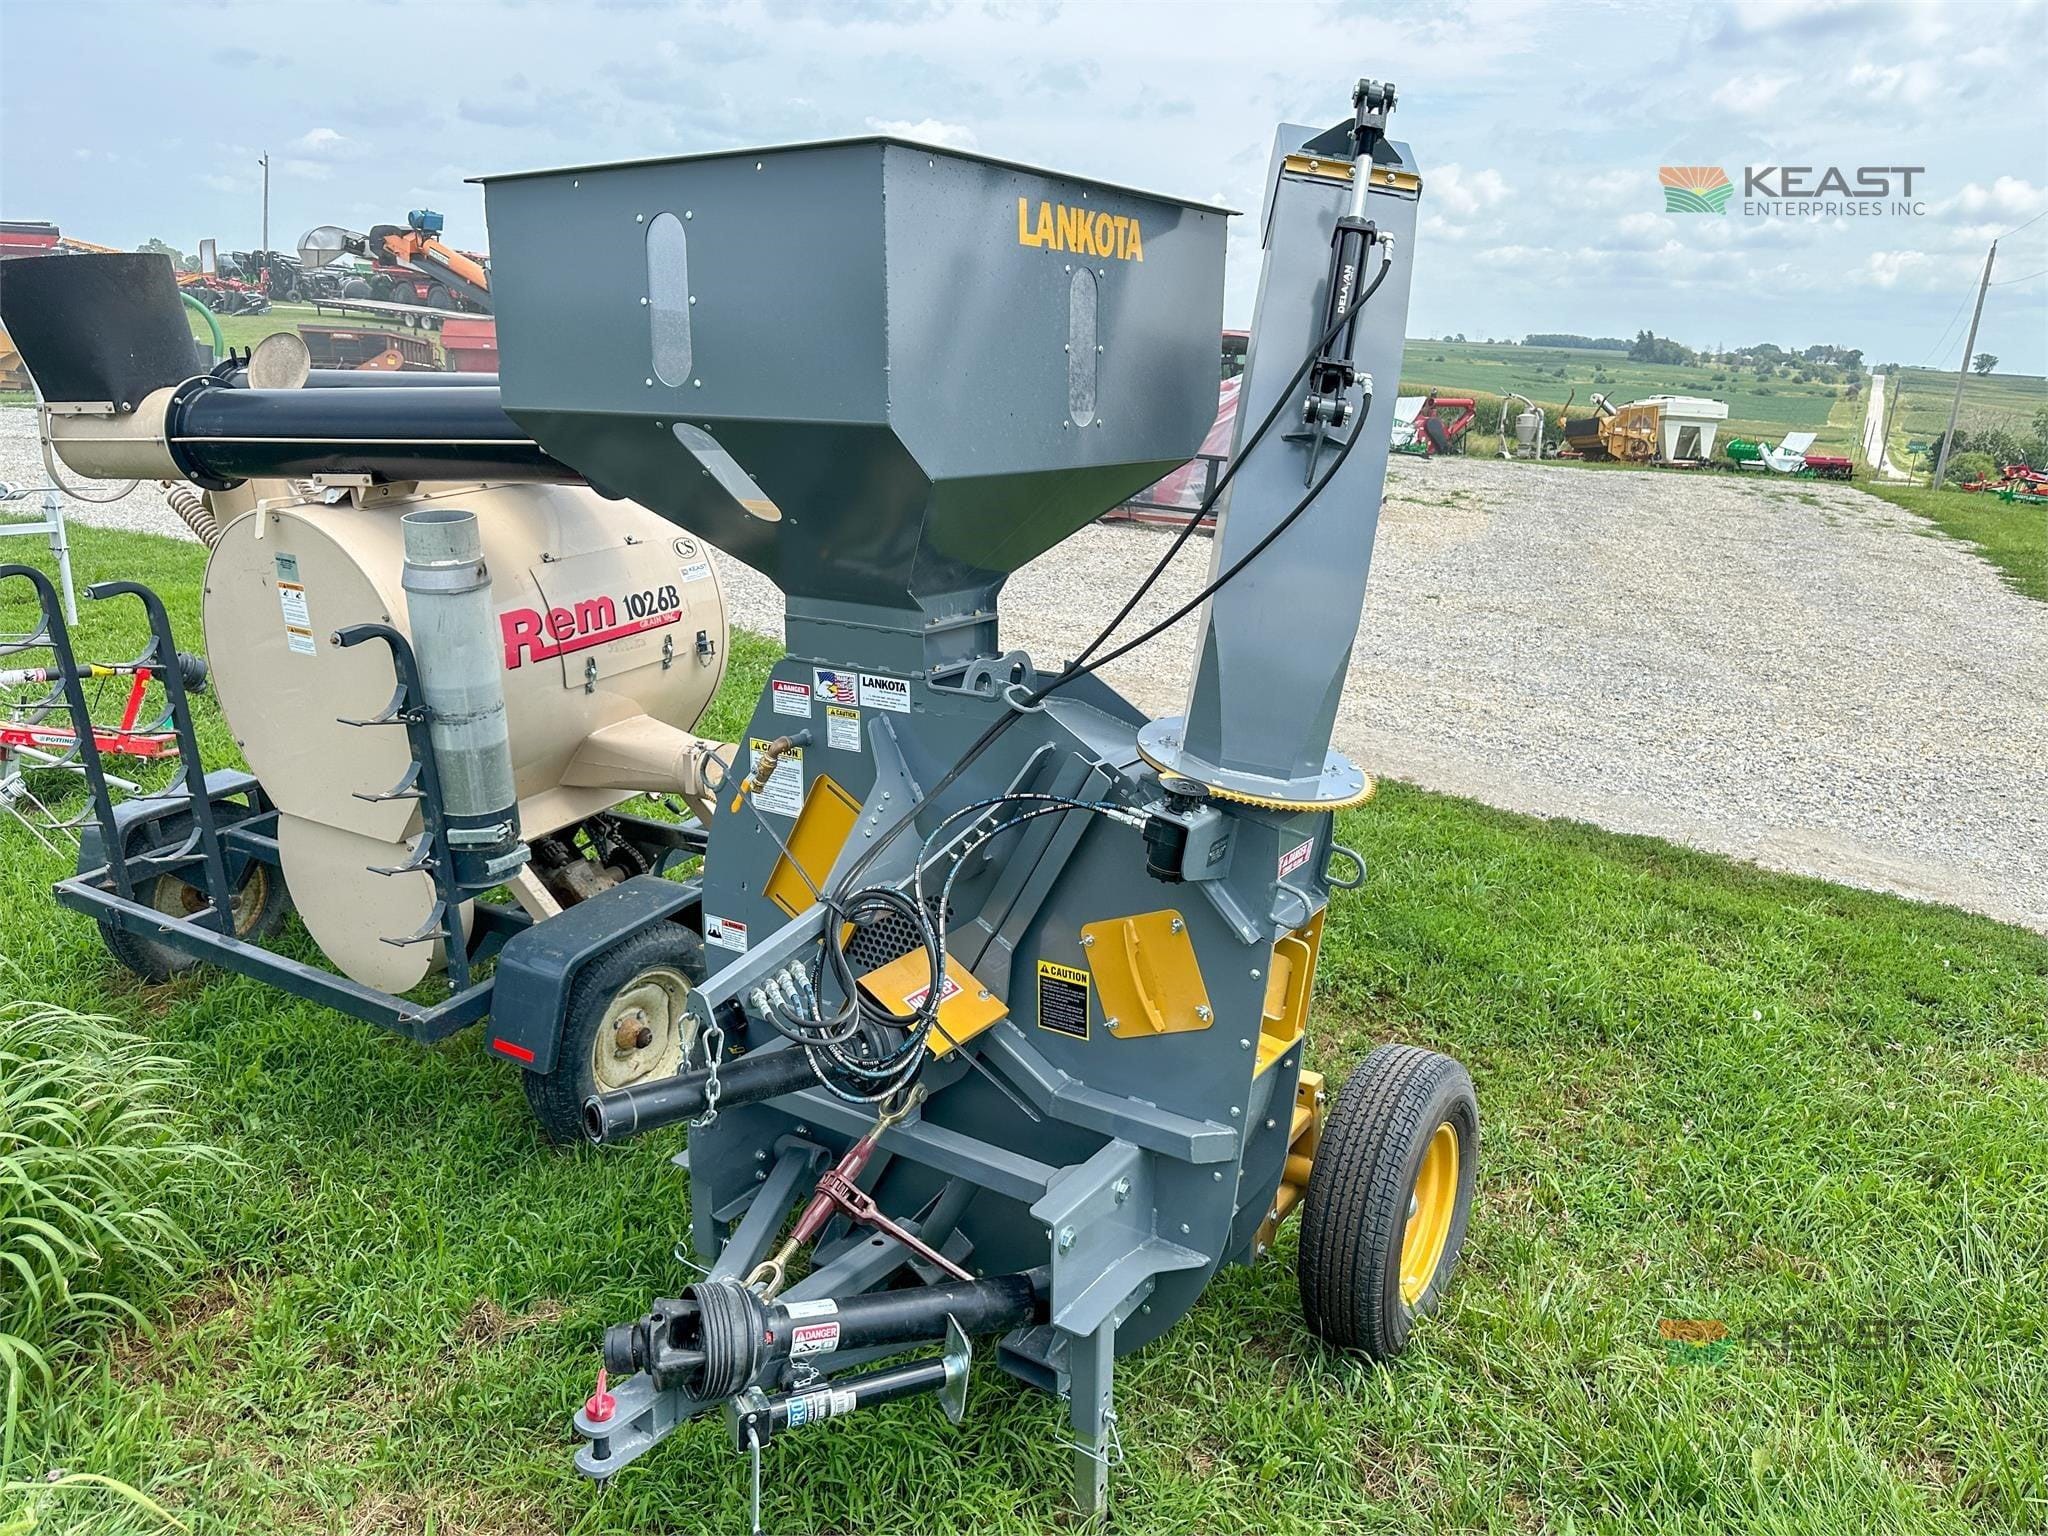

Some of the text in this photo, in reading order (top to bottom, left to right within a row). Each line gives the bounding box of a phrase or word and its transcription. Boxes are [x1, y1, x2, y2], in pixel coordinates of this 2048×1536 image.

[1018, 196, 1144, 263] LANKOTA
[1337, 264, 1354, 314] DELAVAN
[499, 584, 681, 670] Rem 1026B
[639, 615, 662, 628] GRAIN
[783, 684, 805, 694] DANGER
[862, 676, 907, 693] LANKOTA
[836, 709, 857, 719] CAUTION
[1050, 966, 1087, 984] CAUTION
[805, 1327, 837, 1341] DANGER
